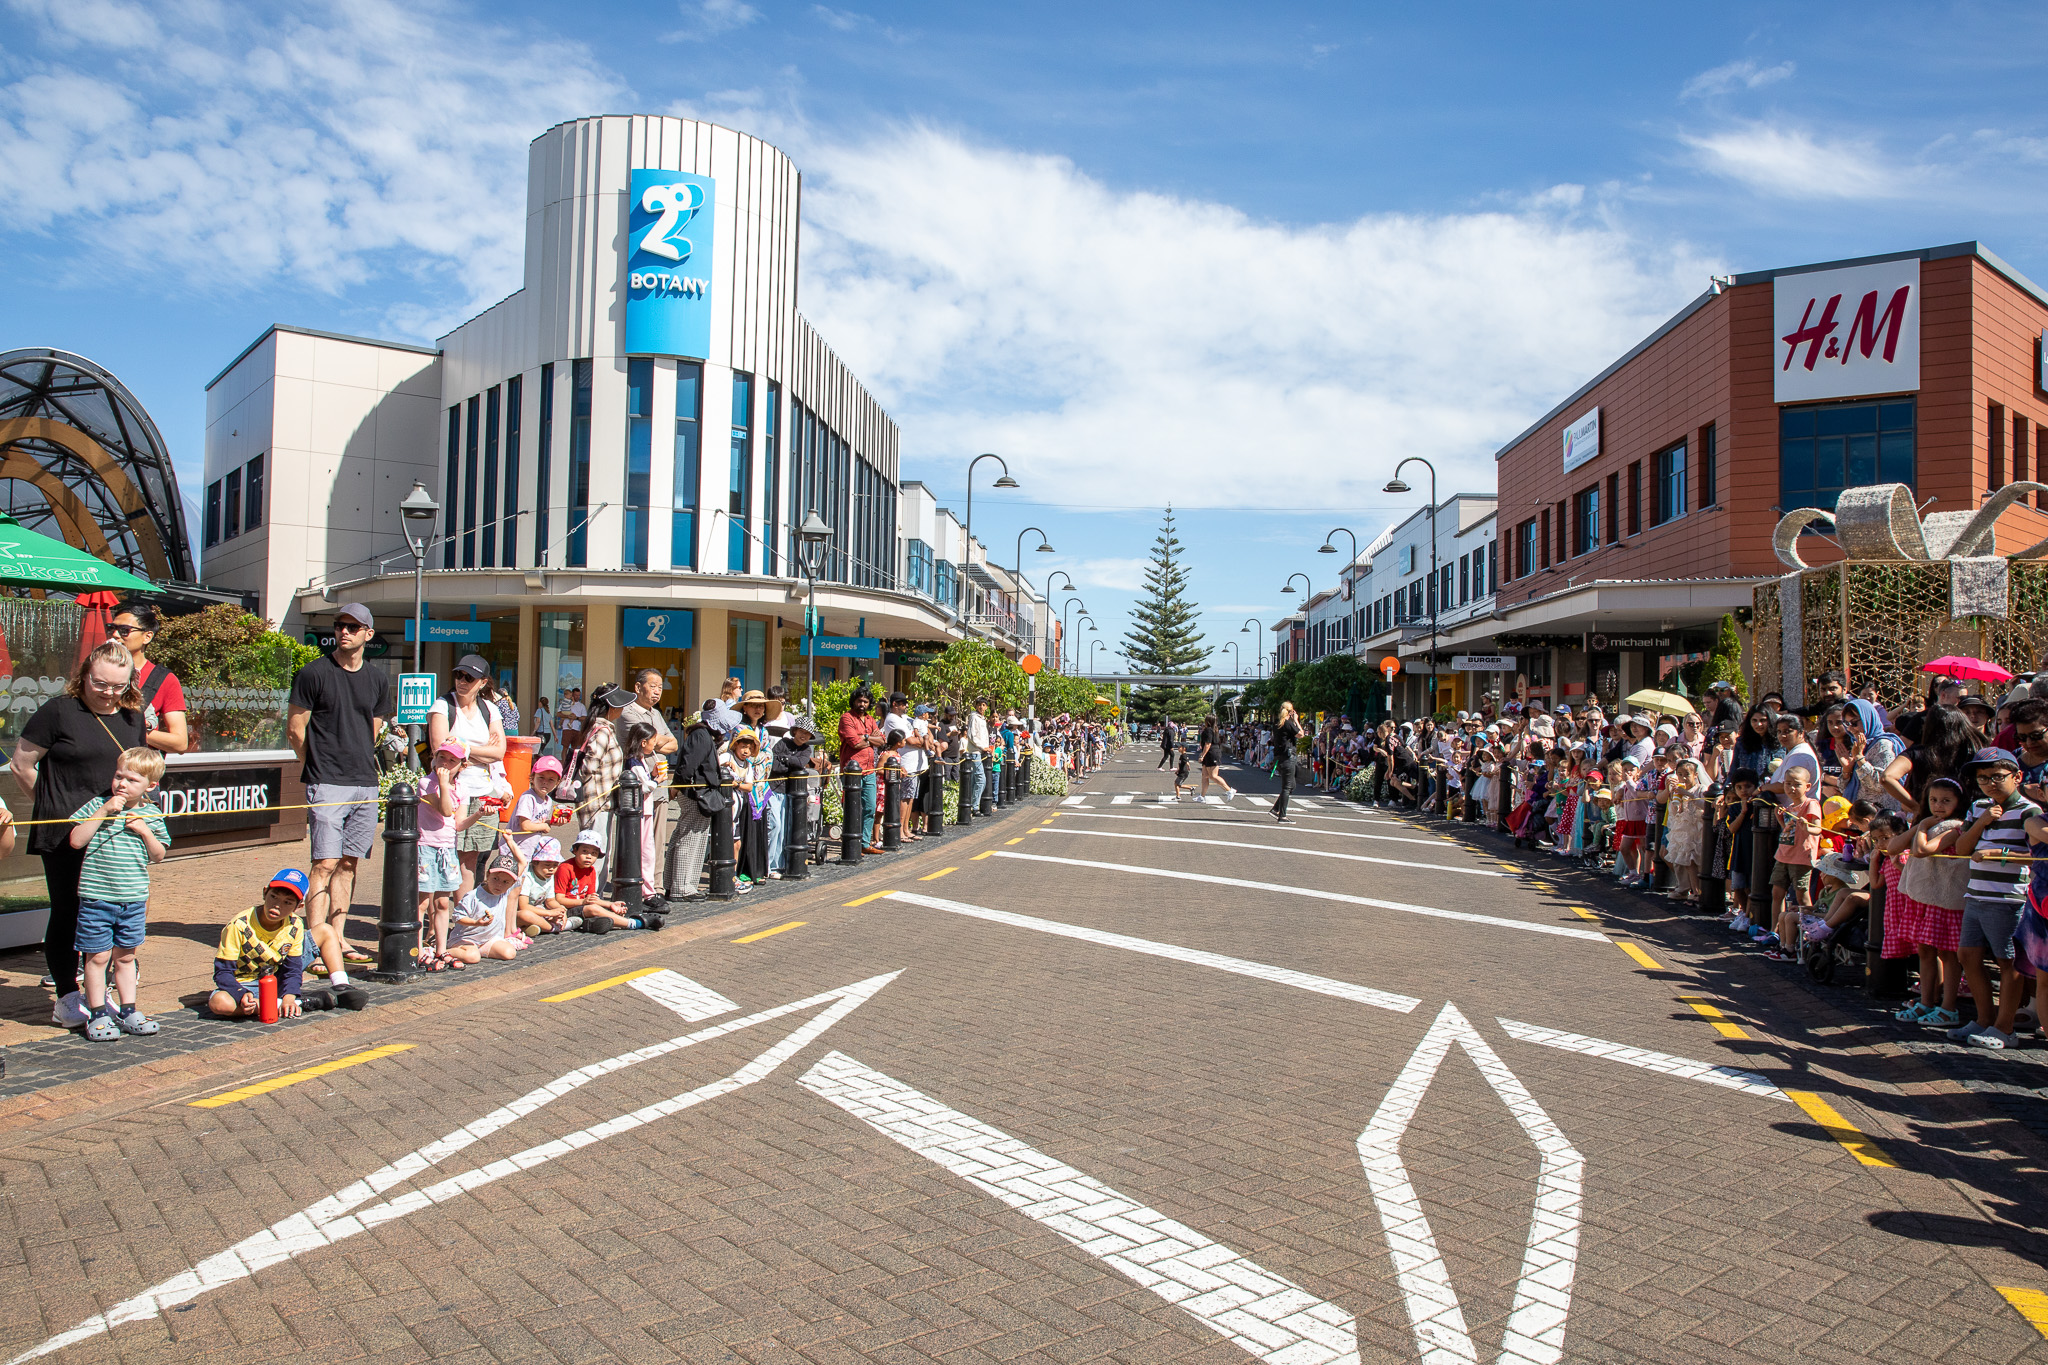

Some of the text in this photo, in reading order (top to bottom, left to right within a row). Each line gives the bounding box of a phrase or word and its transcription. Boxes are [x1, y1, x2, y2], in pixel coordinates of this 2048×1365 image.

[631, 273, 709, 295] BOTANY
[1781, 285, 1910, 372] H&M
[0, 562, 102, 583] eken
[430, 626, 469, 636] 2degrees
[821, 642, 858, 651] 2degrees
[1610, 638, 1670, 646] michael hill
[159, 789, 196, 817] ODE
